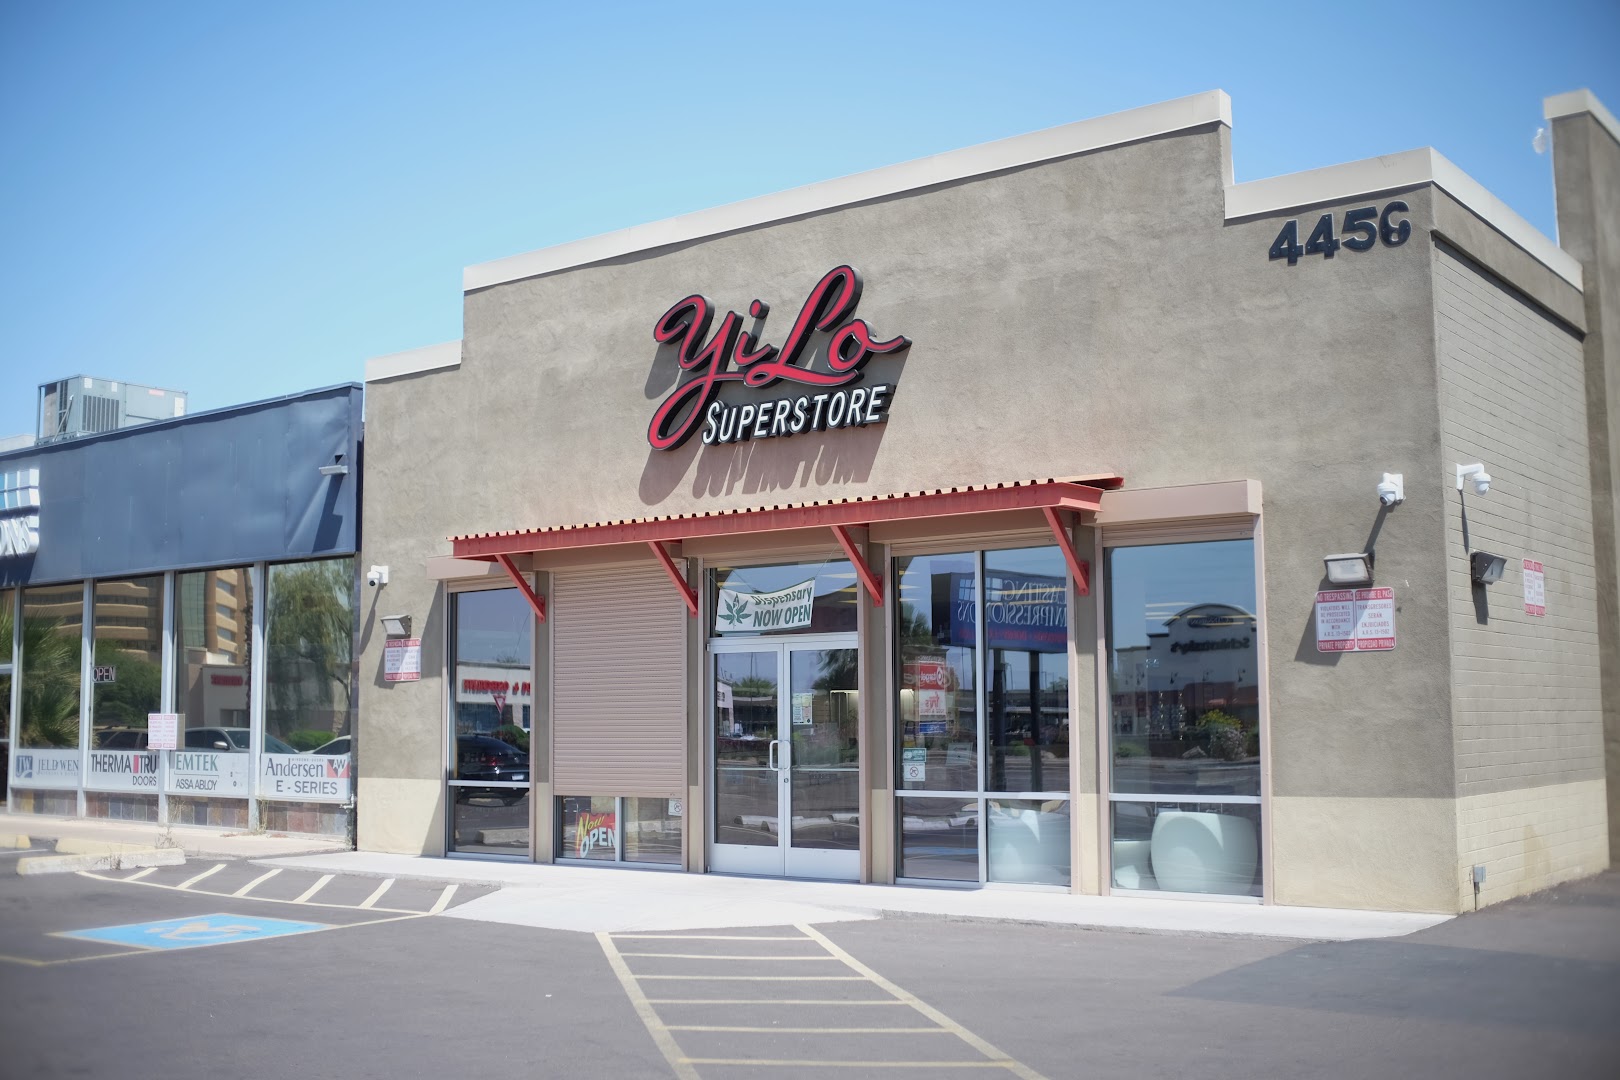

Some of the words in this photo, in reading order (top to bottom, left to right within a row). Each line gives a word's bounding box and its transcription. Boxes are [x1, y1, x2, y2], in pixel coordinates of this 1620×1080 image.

[1269, 200, 1412, 266] 4456
[702, 384, 894, 446] SUPERSTORE
[751, 587, 812, 608] Dispensary
[753, 609, 783, 627] NOW
[784, 604, 811, 625] OPEN
[92, 666, 115, 682] OPEN
[91, 754, 132, 772] THERMA
[140, 755, 157, 774] TRU
[176, 754, 218, 772] EMTEK
[265, 758, 324, 778] Andersen
[132, 776, 157, 786] DOORS
[176, 778, 194, 790] ASSA
[194, 779, 218, 790] ABLOY
[276, 780, 284, 792] E
[294, 781, 338, 794] SERIES
[580, 827, 616, 858] OPEN
